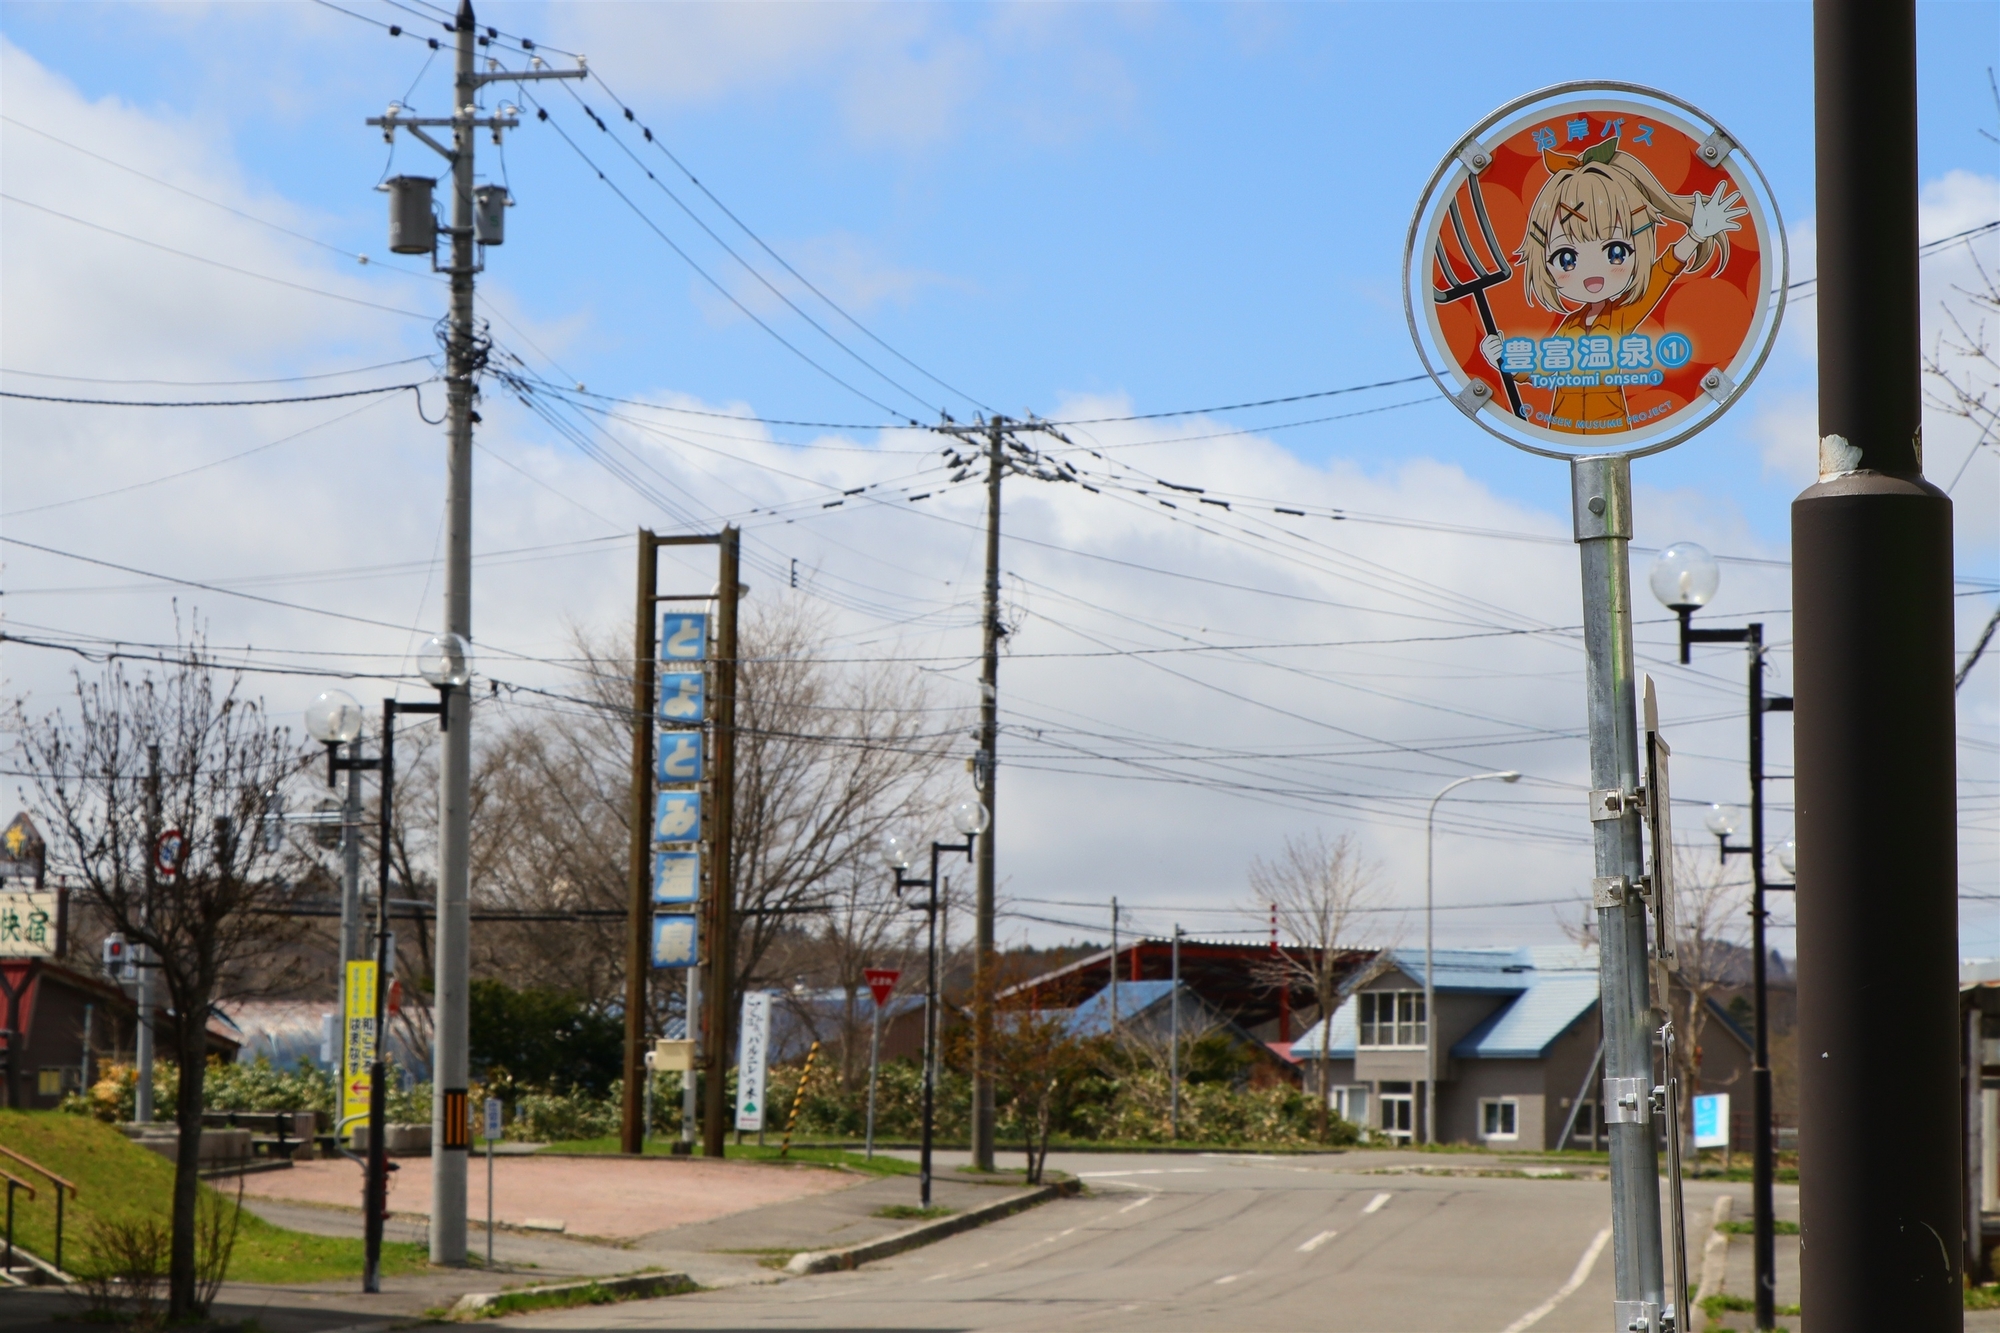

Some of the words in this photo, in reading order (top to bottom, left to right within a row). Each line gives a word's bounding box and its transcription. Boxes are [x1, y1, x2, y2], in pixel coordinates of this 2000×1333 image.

[1532, 118, 1655, 152] 沿岸バス
[1531, 371, 1600, 389] Toyotomi
[1536, 410, 1572, 427] ONSEN
[1575, 419, 1623, 430] MUSUME
[1627, 401, 1673, 424] PROJECT
[656, 618, 700, 964] とよとみ温泉
